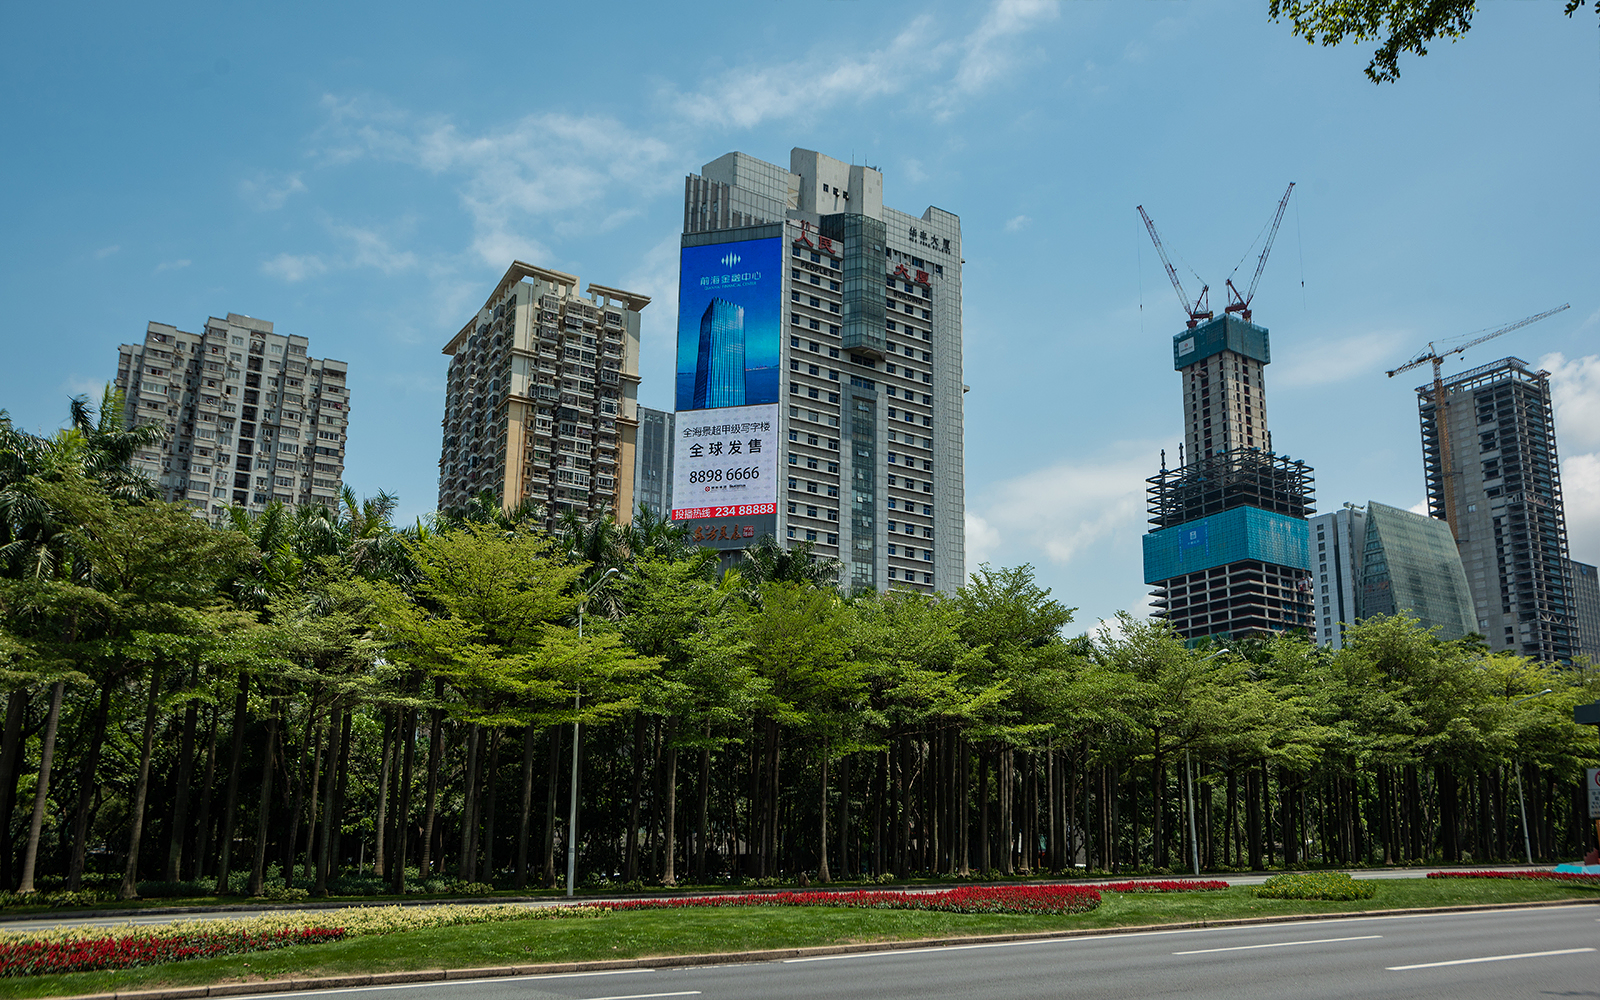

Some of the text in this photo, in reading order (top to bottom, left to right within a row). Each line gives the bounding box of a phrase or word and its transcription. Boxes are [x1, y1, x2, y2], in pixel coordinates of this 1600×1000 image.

[795, 230, 931, 287] 人民 大厦
[700, 271, 762, 286] 前海金融中心
[893, 291, 923, 305] BUILDING
[683, 422, 770, 438] 全海景超甲级写字楼
[690, 439, 762, 457] 全球发售
[690, 467, 759, 483] 8898 6666
[675, 503, 774, 520] 投播热线 234 88888
